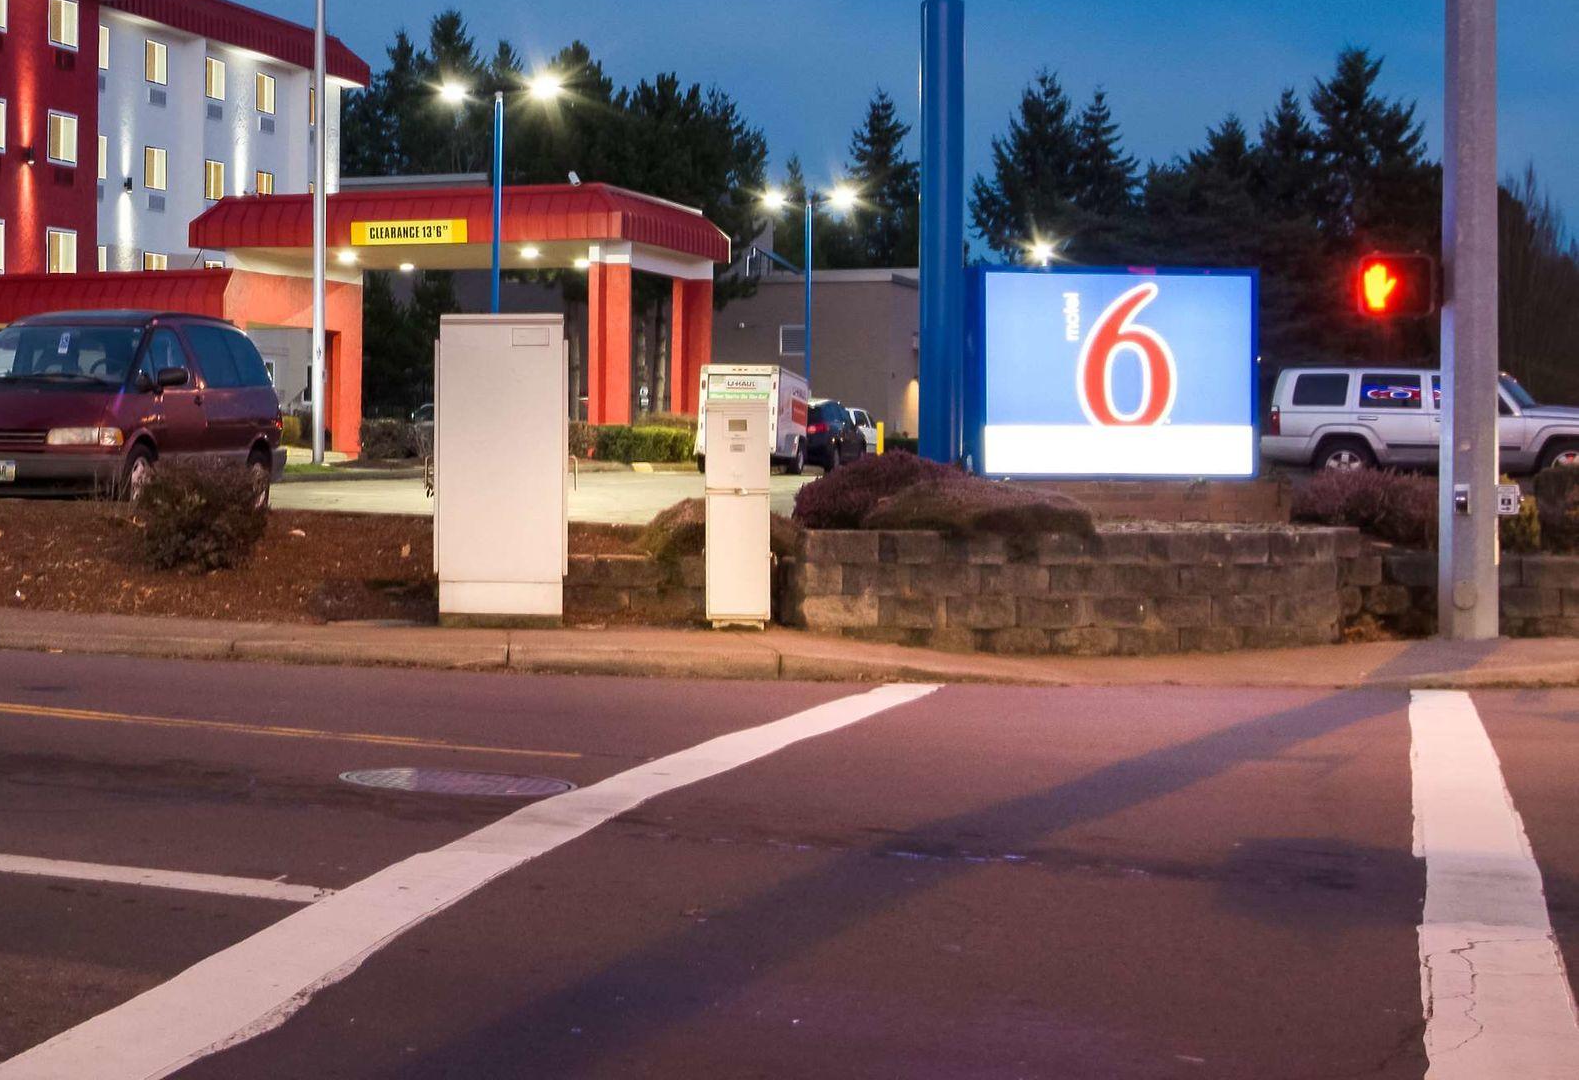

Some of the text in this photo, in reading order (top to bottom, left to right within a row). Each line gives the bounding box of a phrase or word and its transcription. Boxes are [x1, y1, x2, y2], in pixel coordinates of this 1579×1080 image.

[369, 225, 448, 240] CLEARANCE 13'6"
[1076, 282, 1178, 427] 6
